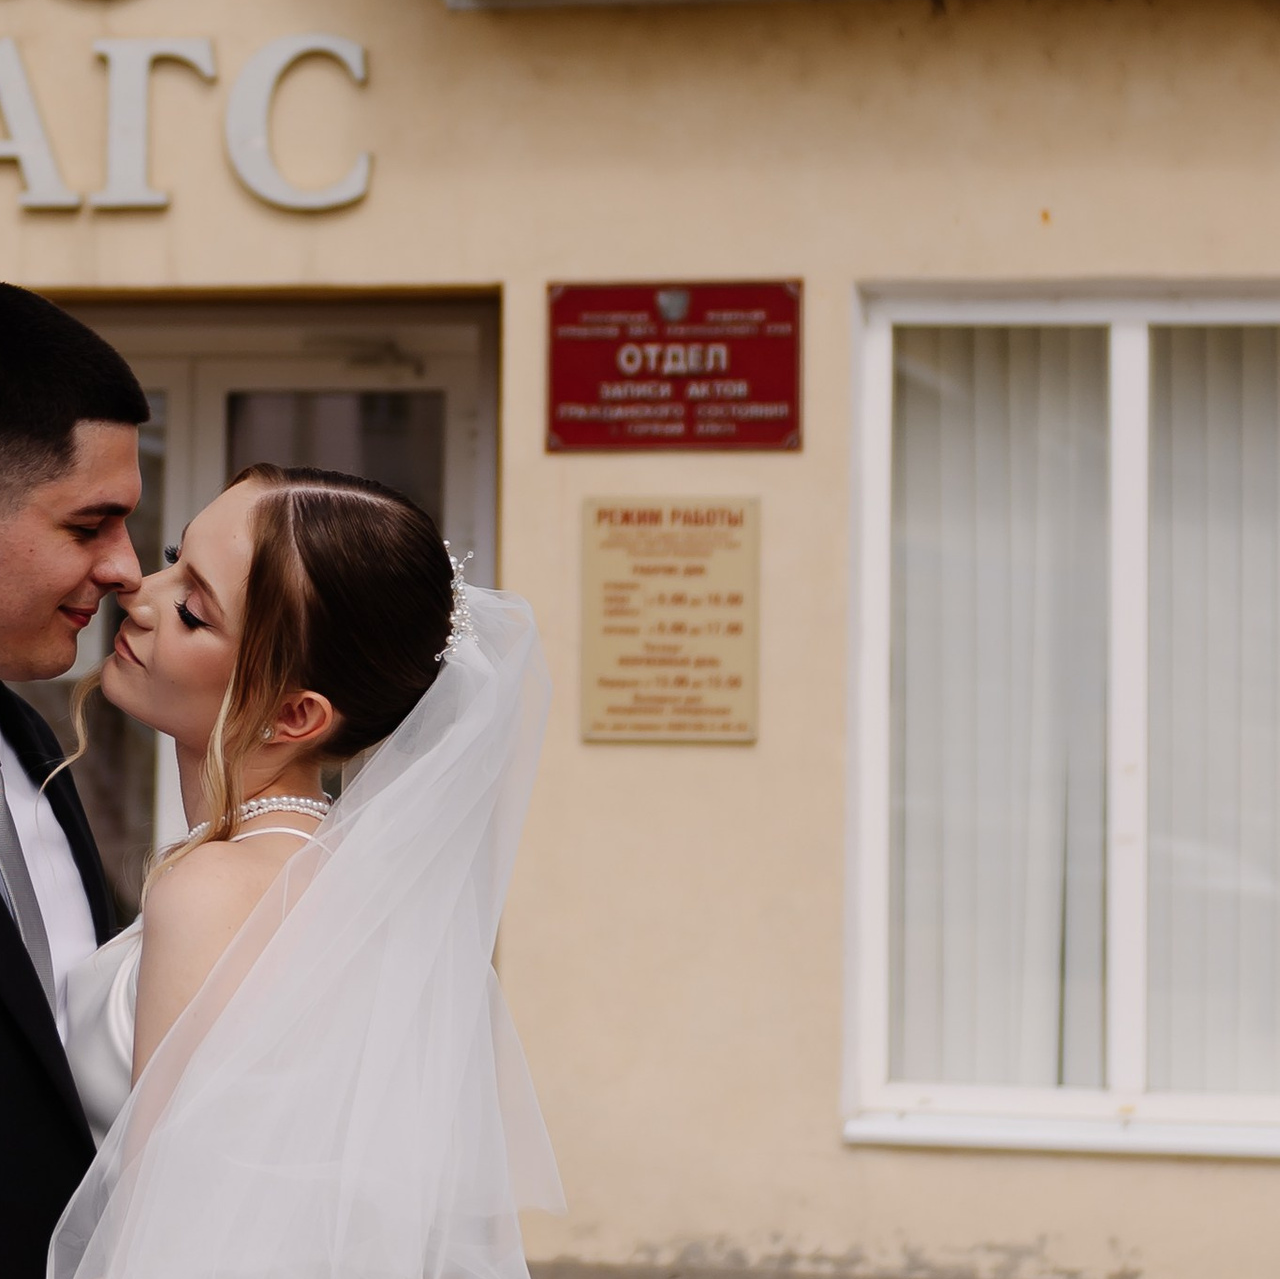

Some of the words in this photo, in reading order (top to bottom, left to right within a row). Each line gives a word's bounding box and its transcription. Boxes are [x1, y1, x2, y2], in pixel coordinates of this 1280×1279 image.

[618, 342, 730, 375] ОТДЕЛ
[596, 507, 663, 527] РЕЖИМ
[671, 507, 745, 527] РАБОТЫ
